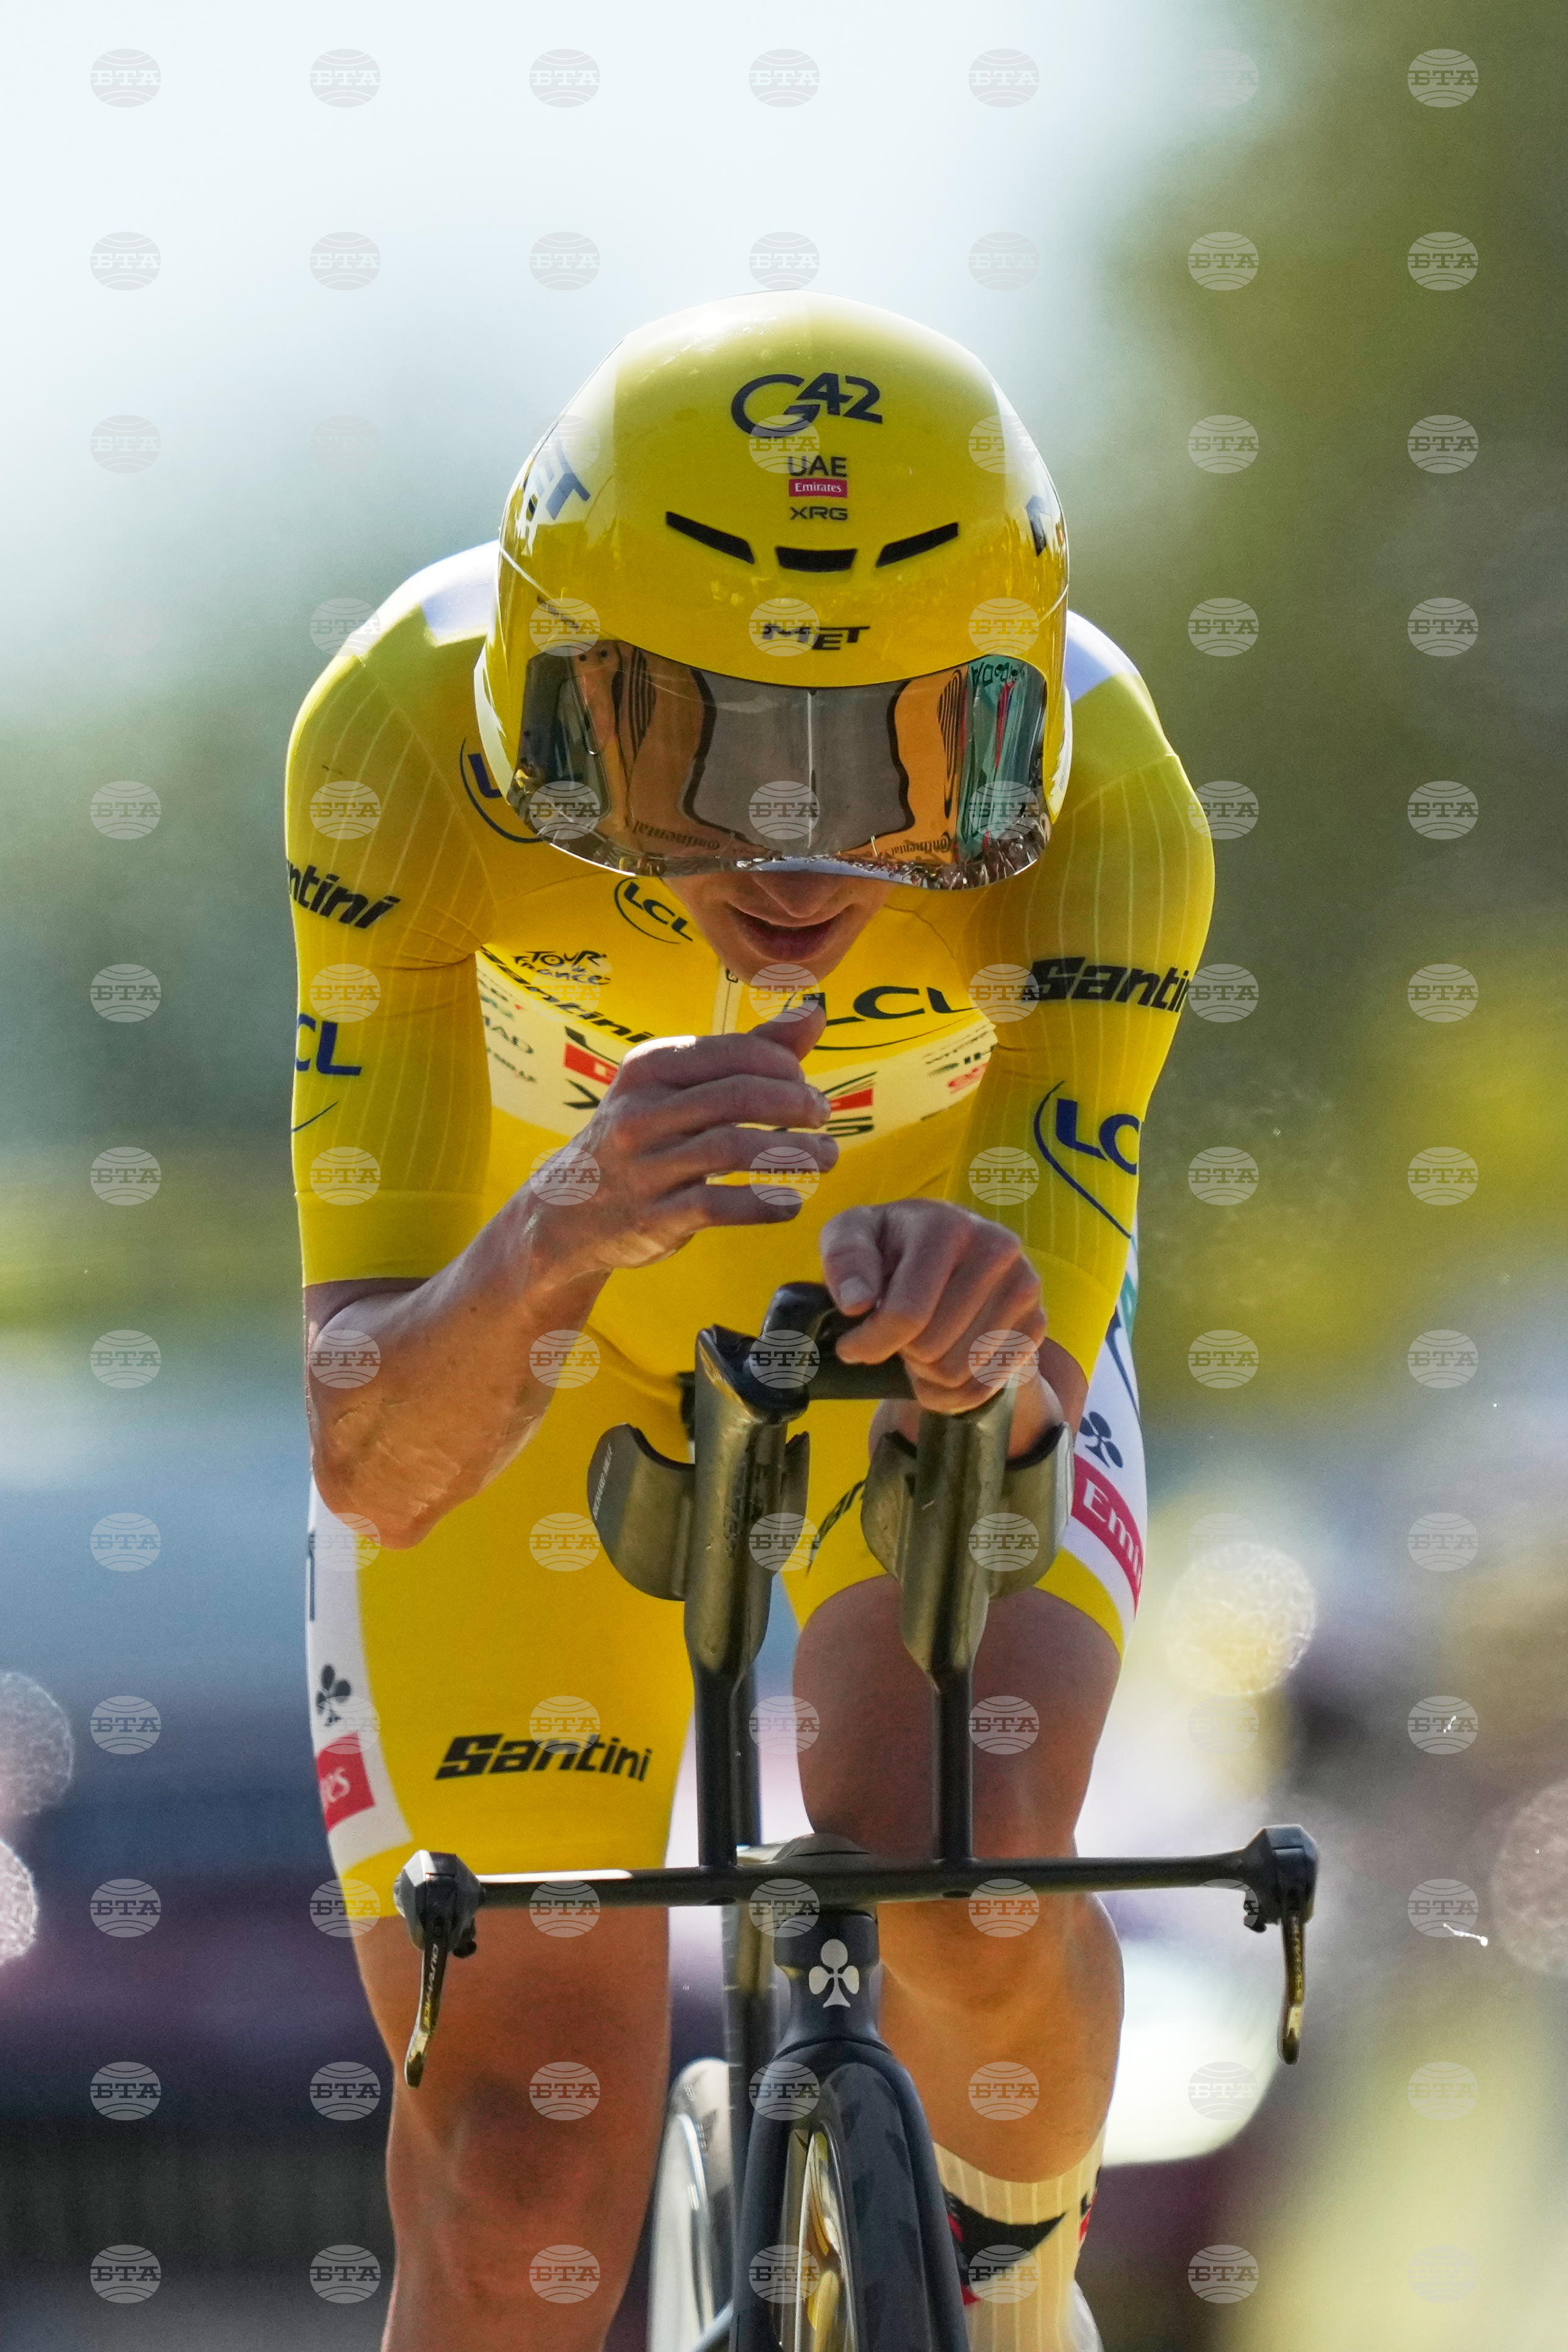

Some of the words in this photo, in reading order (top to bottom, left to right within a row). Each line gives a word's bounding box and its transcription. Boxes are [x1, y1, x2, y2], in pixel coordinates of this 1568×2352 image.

[788, 456, 847, 477] UAE
[795, 482, 842, 493] Emirates
[790, 506, 848, 520] XRG
[761, 623, 870, 650] MET
[624, 881, 693, 941] LCL
[1022, 956, 1189, 1013] Santi
[296, 1013, 362, 1076] CL
[1056, 1098, 1140, 1175] LC
[435, 1734, 653, 1782] Santini
